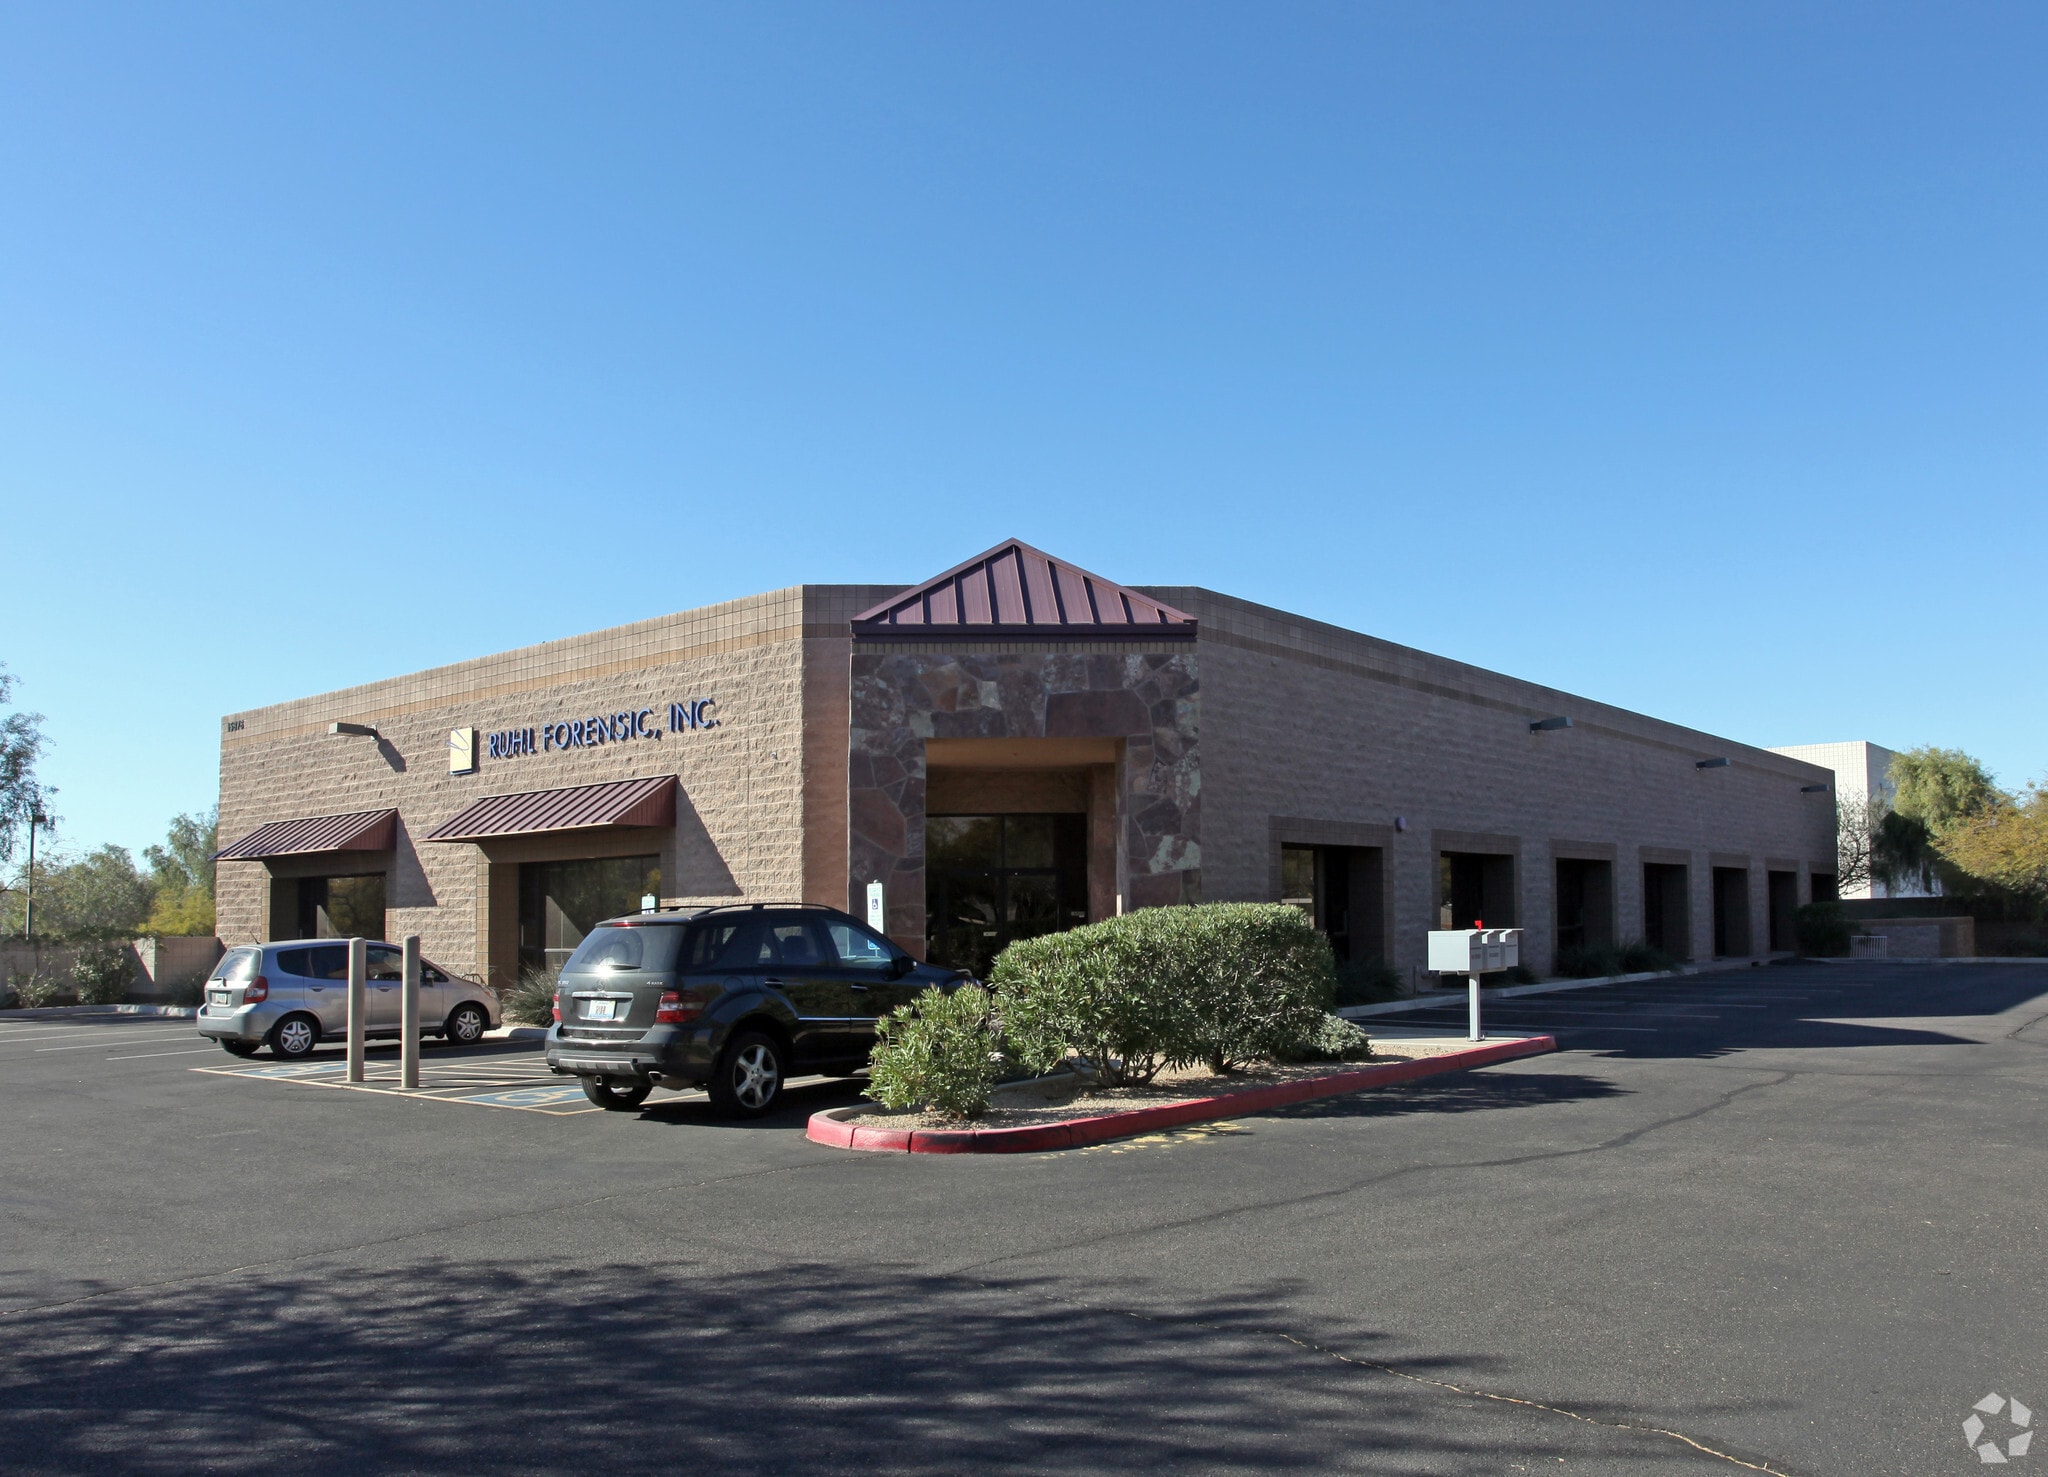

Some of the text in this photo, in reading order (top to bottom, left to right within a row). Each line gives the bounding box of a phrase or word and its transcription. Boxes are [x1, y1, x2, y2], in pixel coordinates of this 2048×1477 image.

[489, 698, 720, 758] RUHL FORENSIC, INC.
